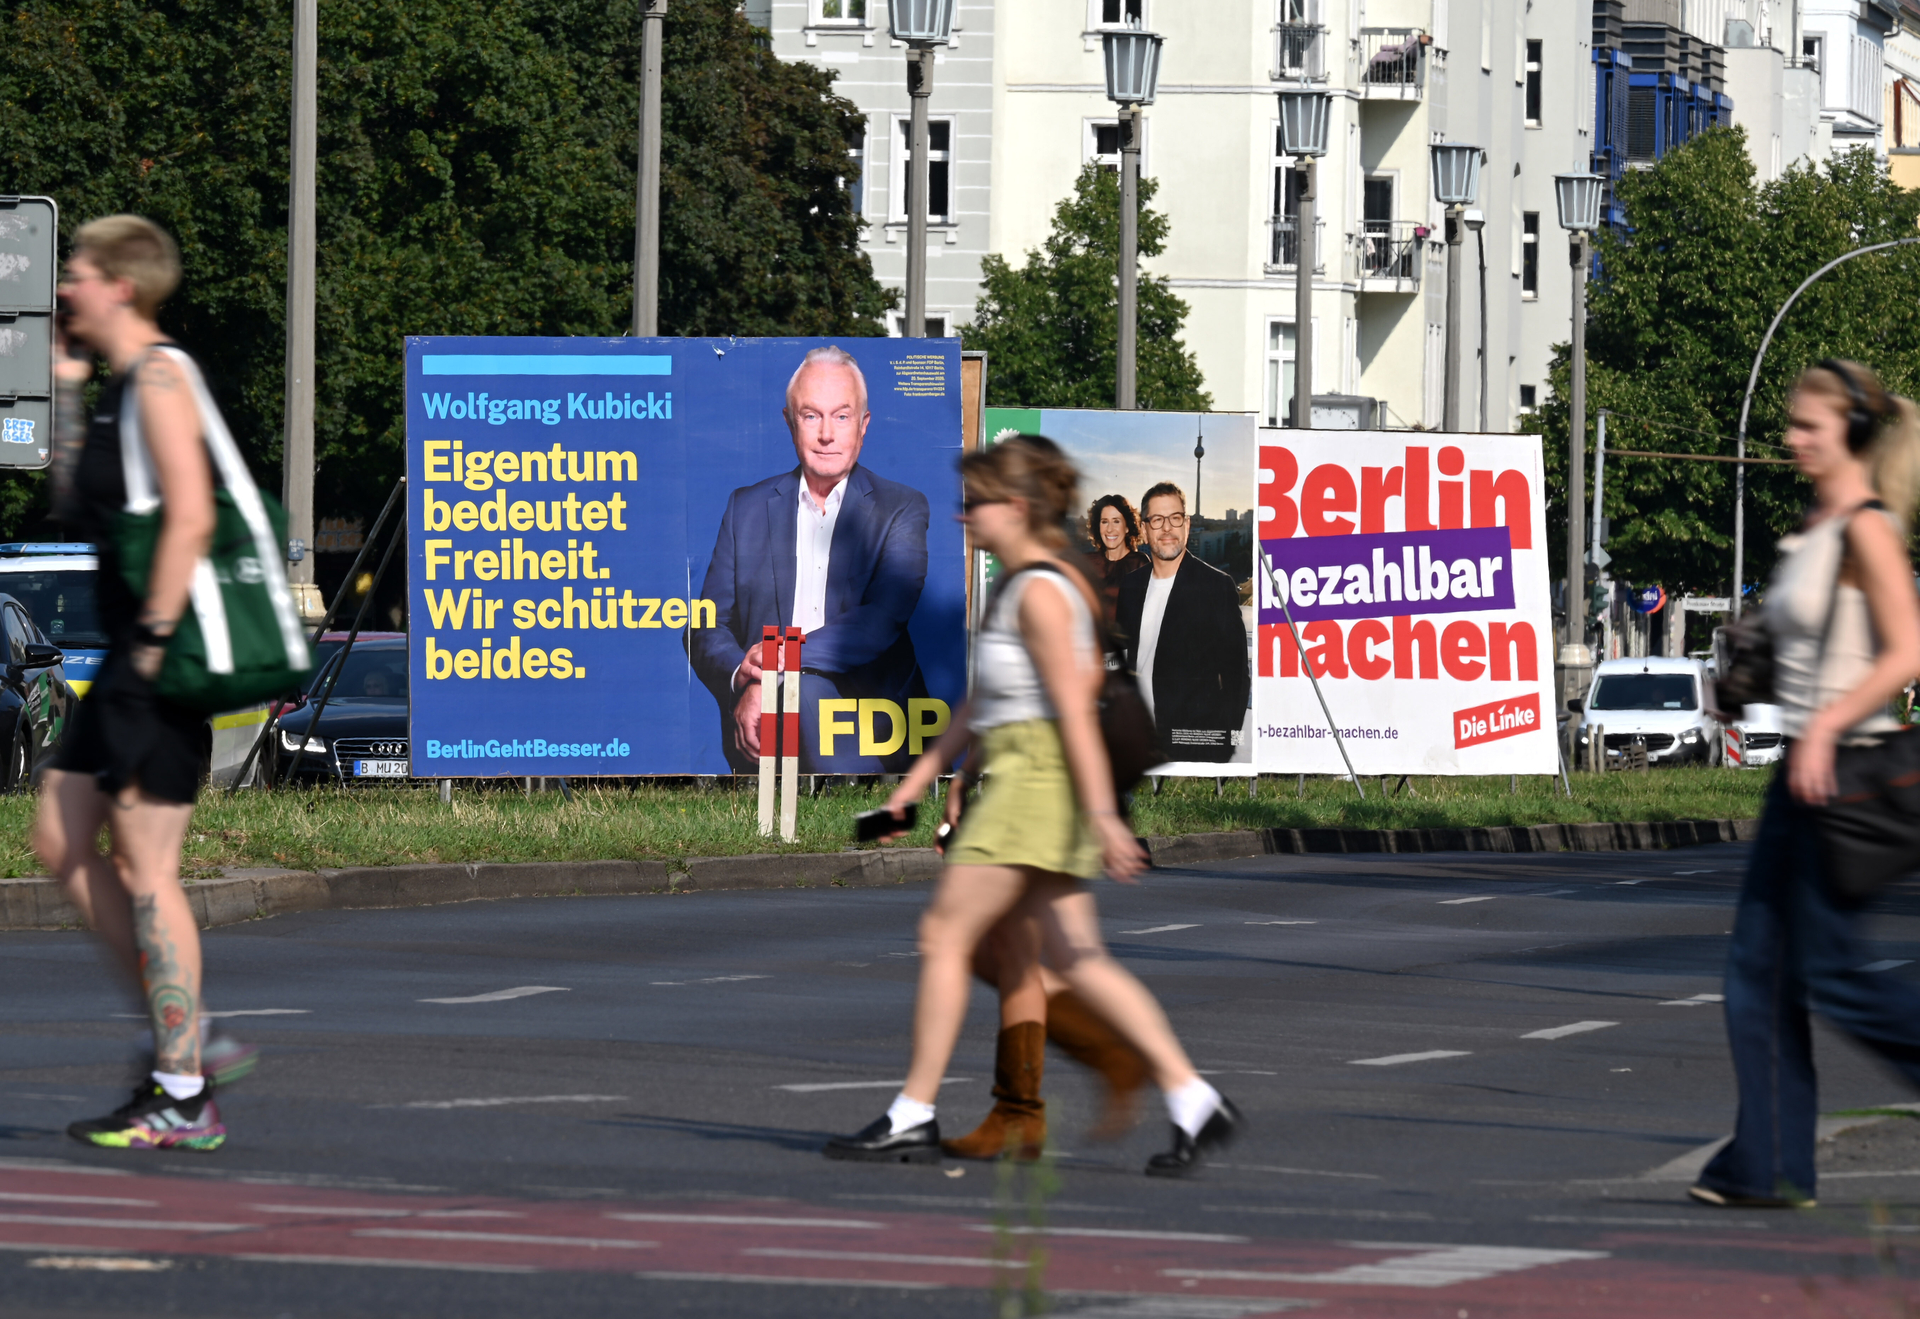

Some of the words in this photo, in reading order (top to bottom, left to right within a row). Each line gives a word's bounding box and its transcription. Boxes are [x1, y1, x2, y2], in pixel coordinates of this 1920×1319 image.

[422, 392, 561, 425] Wolfgang
[567, 392, 672, 420] Kubicki
[424, 440, 638, 491] Eigentum
[424, 489, 627, 531] bedeutet
[1258, 445, 1533, 550] Berlin
[425, 538, 610, 580] Freiheit.
[1261, 545, 1503, 609] bezahlbar
[423, 588, 503, 630] Wir
[513, 586, 716, 629] schützen
[425, 636, 586, 680] beides.
[818, 697, 952, 756] FDP
[1460, 715, 1487, 740] Die
[1489, 704, 1535, 733] Linke
[361, 763, 368, 773] B
[426, 738, 630, 758] BerlinGehtBesser.de
